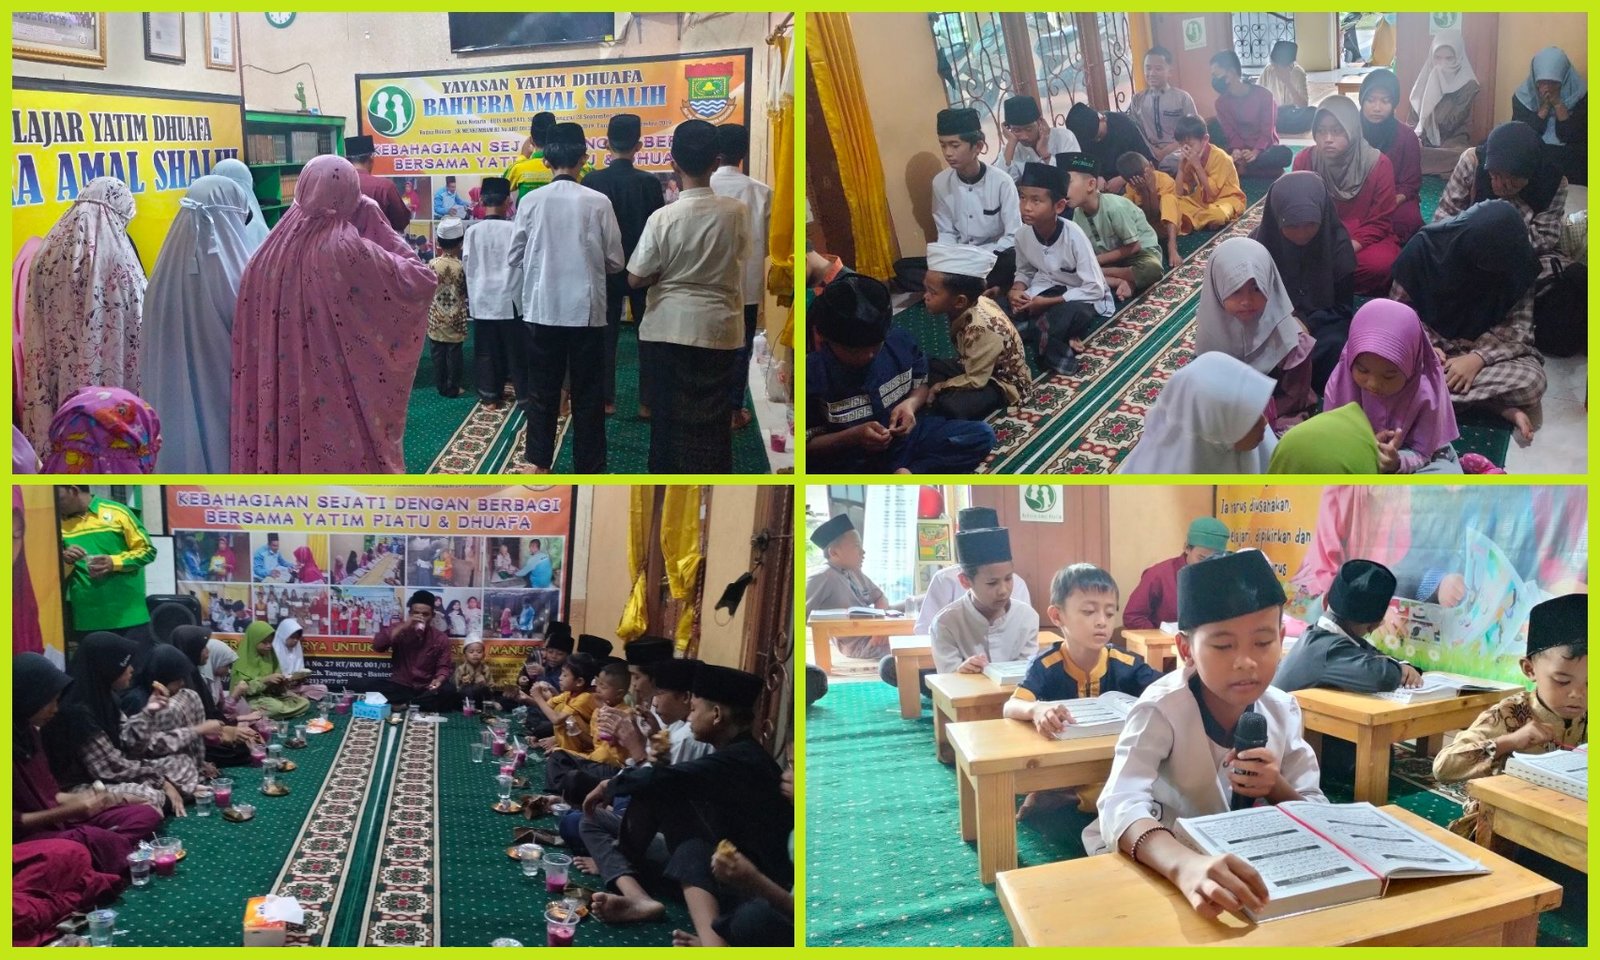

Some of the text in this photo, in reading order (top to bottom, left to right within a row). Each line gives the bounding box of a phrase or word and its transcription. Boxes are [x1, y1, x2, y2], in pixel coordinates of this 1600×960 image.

[441, 69, 643, 95] YAYASAN YATIM DHUAFA
[422, 85, 667, 117] BAHTERA AMAL SHALIH
[89, 112, 148, 142] YATIM
[152, 115, 213, 142] DHUAFA
[374, 140, 521, 156] KEBAHAGIAAN SEJ
[394, 157, 469, 171] BERSAMA
[57, 150, 145, 201] AMAL
[178, 492, 561, 513] KEBAHAGIAAN SEJATI DENGAN BERBAGI
[205, 510, 531, 530] BERSAMA YATIM PIATU & DHUAFA
[1294, 527, 1312, 545] dan
[332, 641, 375, 652] UNTUK
[489, 645, 534, 655] MANUS
[324, 670, 363, 678] Tangerang
